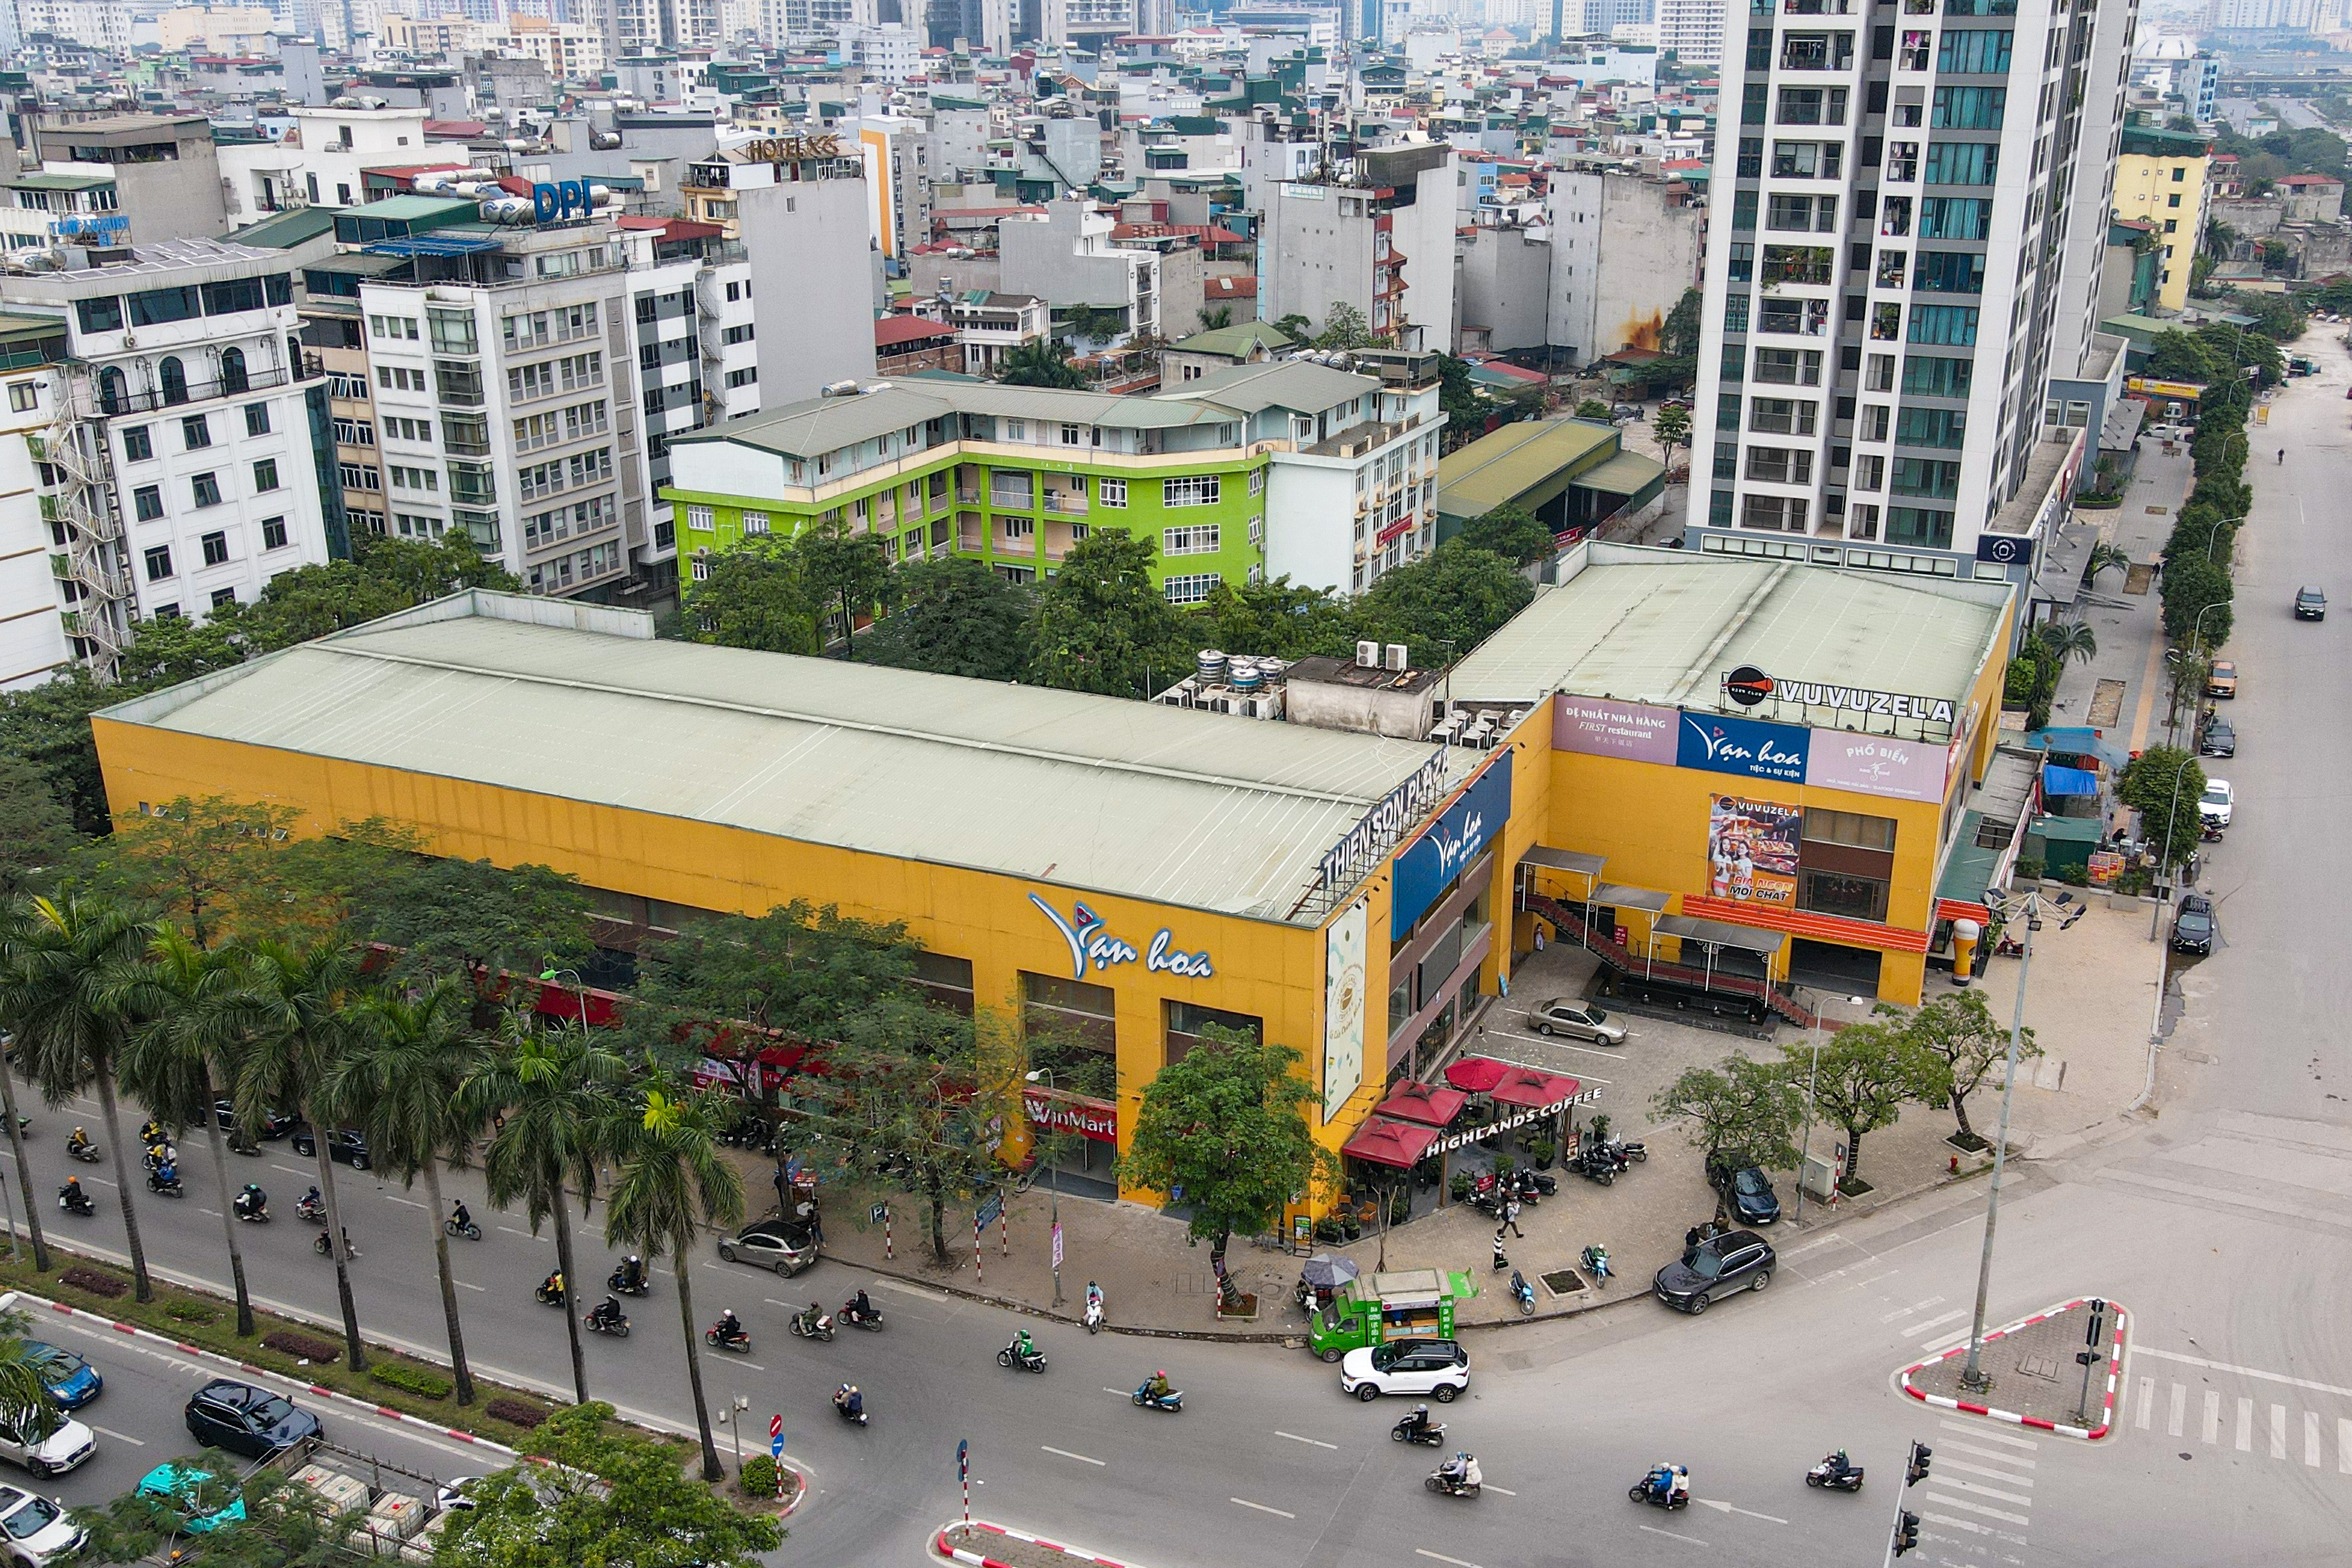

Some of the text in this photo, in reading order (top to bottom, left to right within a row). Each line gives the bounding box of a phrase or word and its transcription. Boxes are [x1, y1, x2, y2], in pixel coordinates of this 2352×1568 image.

[750, 136, 803, 161] HOTEL
[533, 178, 593, 223] DPI
[1779, 679, 1953, 723] VUVUZELA
[1579, 721, 1653, 739] FIRST restaurant
[1636, 716, 1666, 729] HÀNG
[1758, 740, 1801, 765] hoa
[1846, 743, 1875, 758] PHỐ
[1407, 746, 1451, 809] PLAZA
[1738, 801, 1799, 818] VUVUZELA
[1733, 876, 1754, 887] BIA
[1029, 893, 1212, 979] Vạn hoa
[1024, 1099, 1115, 1136] WinMart
[1425, 1087, 1602, 1159] HIGHLANDS COFFEE
[873, 1206, 883, 1219] P
